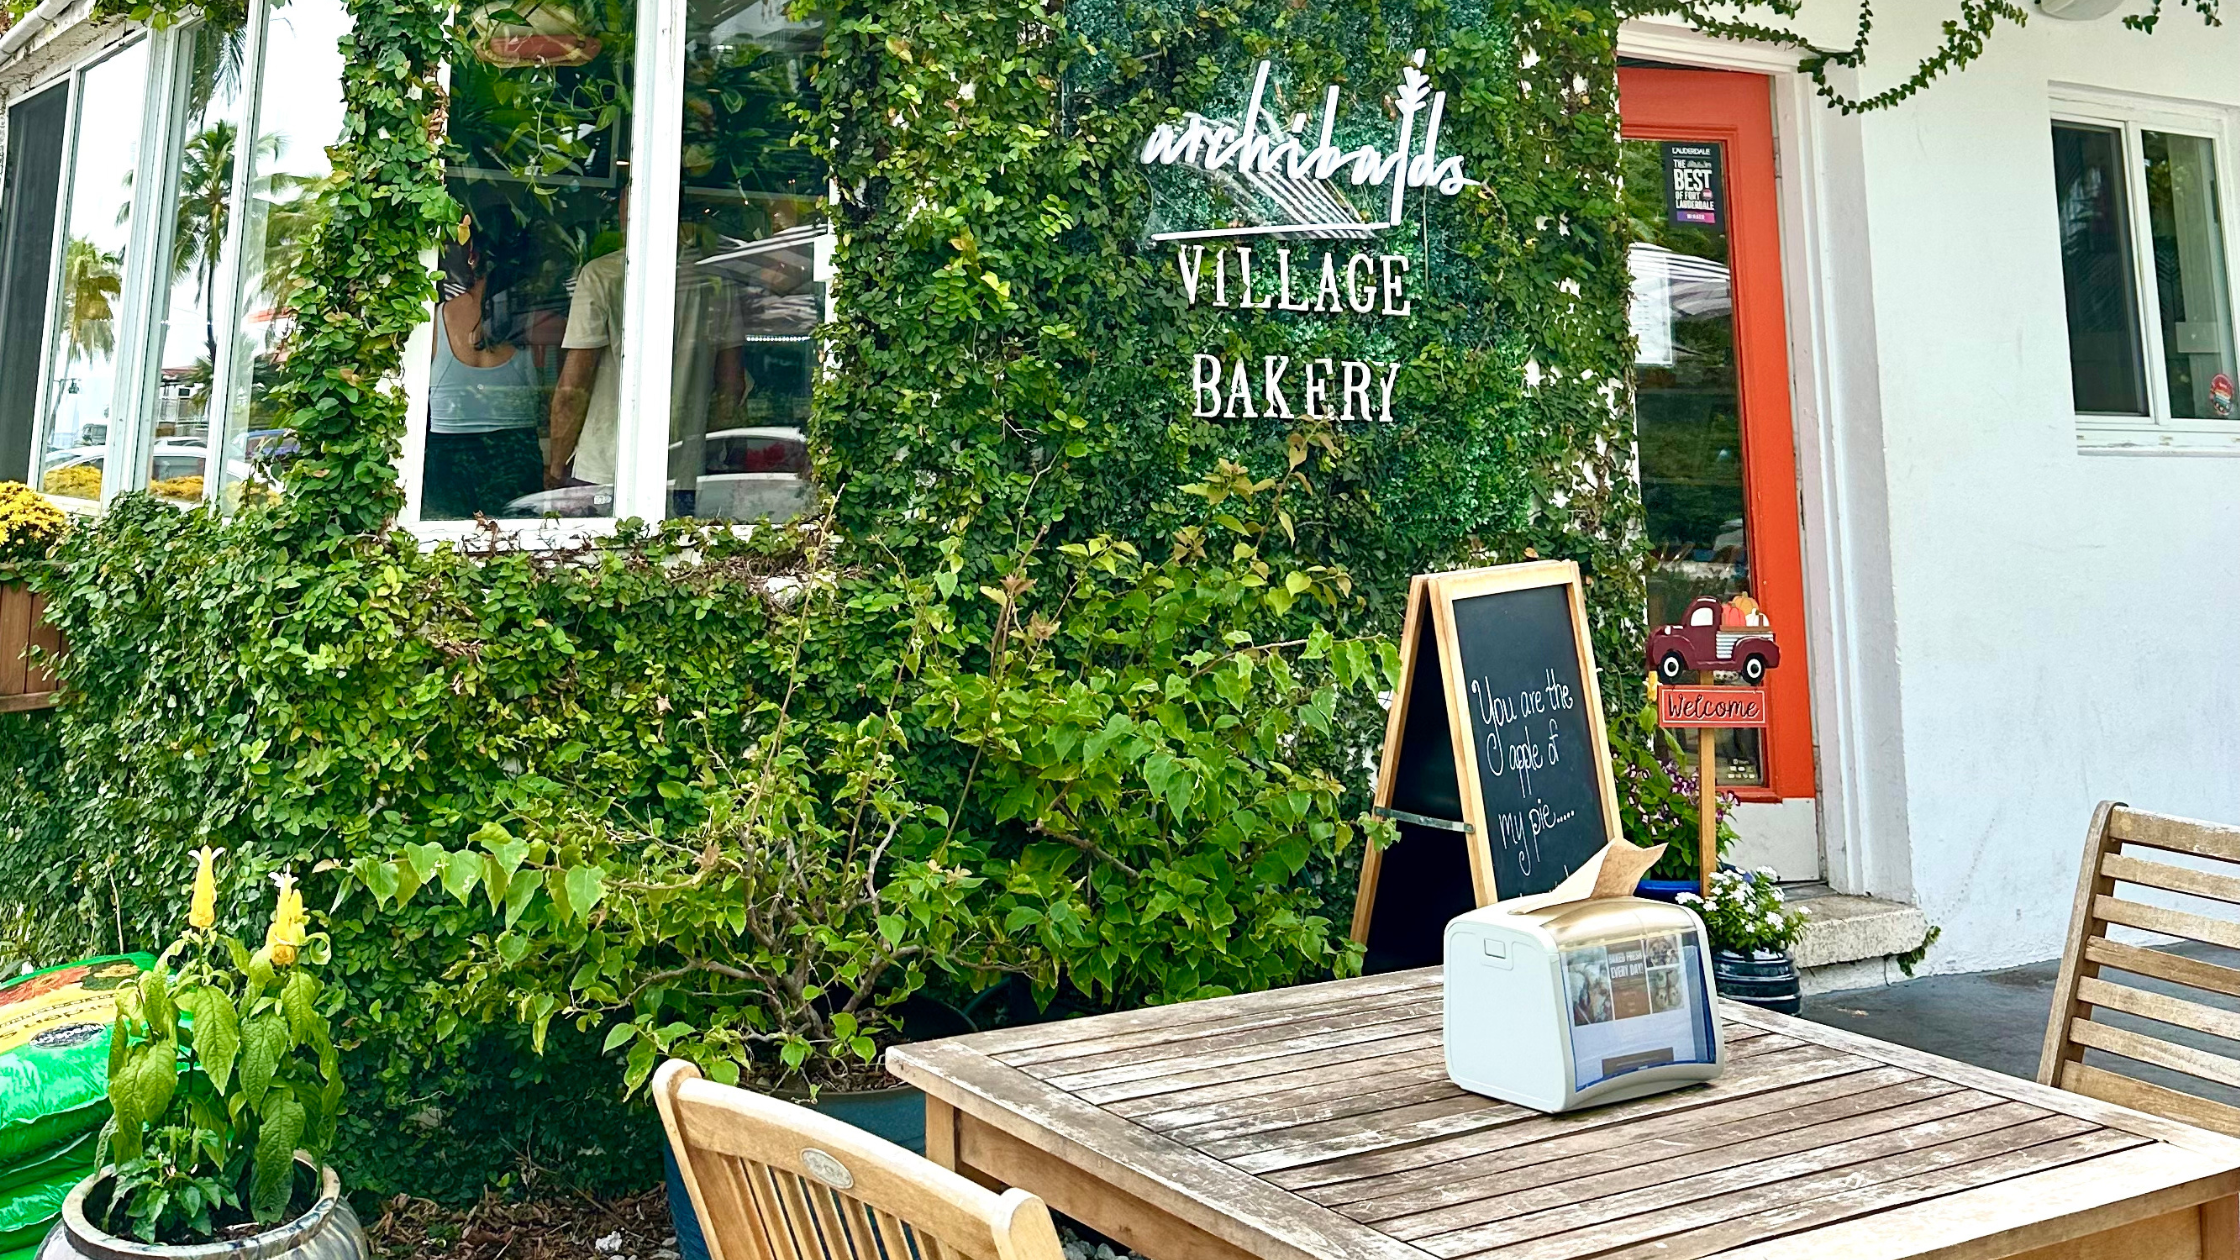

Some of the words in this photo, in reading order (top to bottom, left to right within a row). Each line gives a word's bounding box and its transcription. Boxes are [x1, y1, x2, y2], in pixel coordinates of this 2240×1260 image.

[1140, 48, 1482, 226] archibalds
[1672, 147, 1711, 155] LAUDERDALE
[1673, 159, 1686, 168] THE
[1674, 169, 1712, 191] BEST
[1675, 191, 1683, 199] OF
[1684, 191, 1700, 200] FORT
[1676, 200, 1715, 210] LAUDERDALE
[1178, 245, 1411, 316] VILLAGE
[1192, 354, 1400, 422] BAKERY
[1471, 676, 1517, 776] You
[1520, 690, 1545, 718] are
[1545, 668, 1574, 711] the
[1668, 693, 1760, 720] Welcome
[1508, 726, 1544, 799] apple
[1547, 718, 1560, 766] of
[1498, 811, 1531, 877] my
